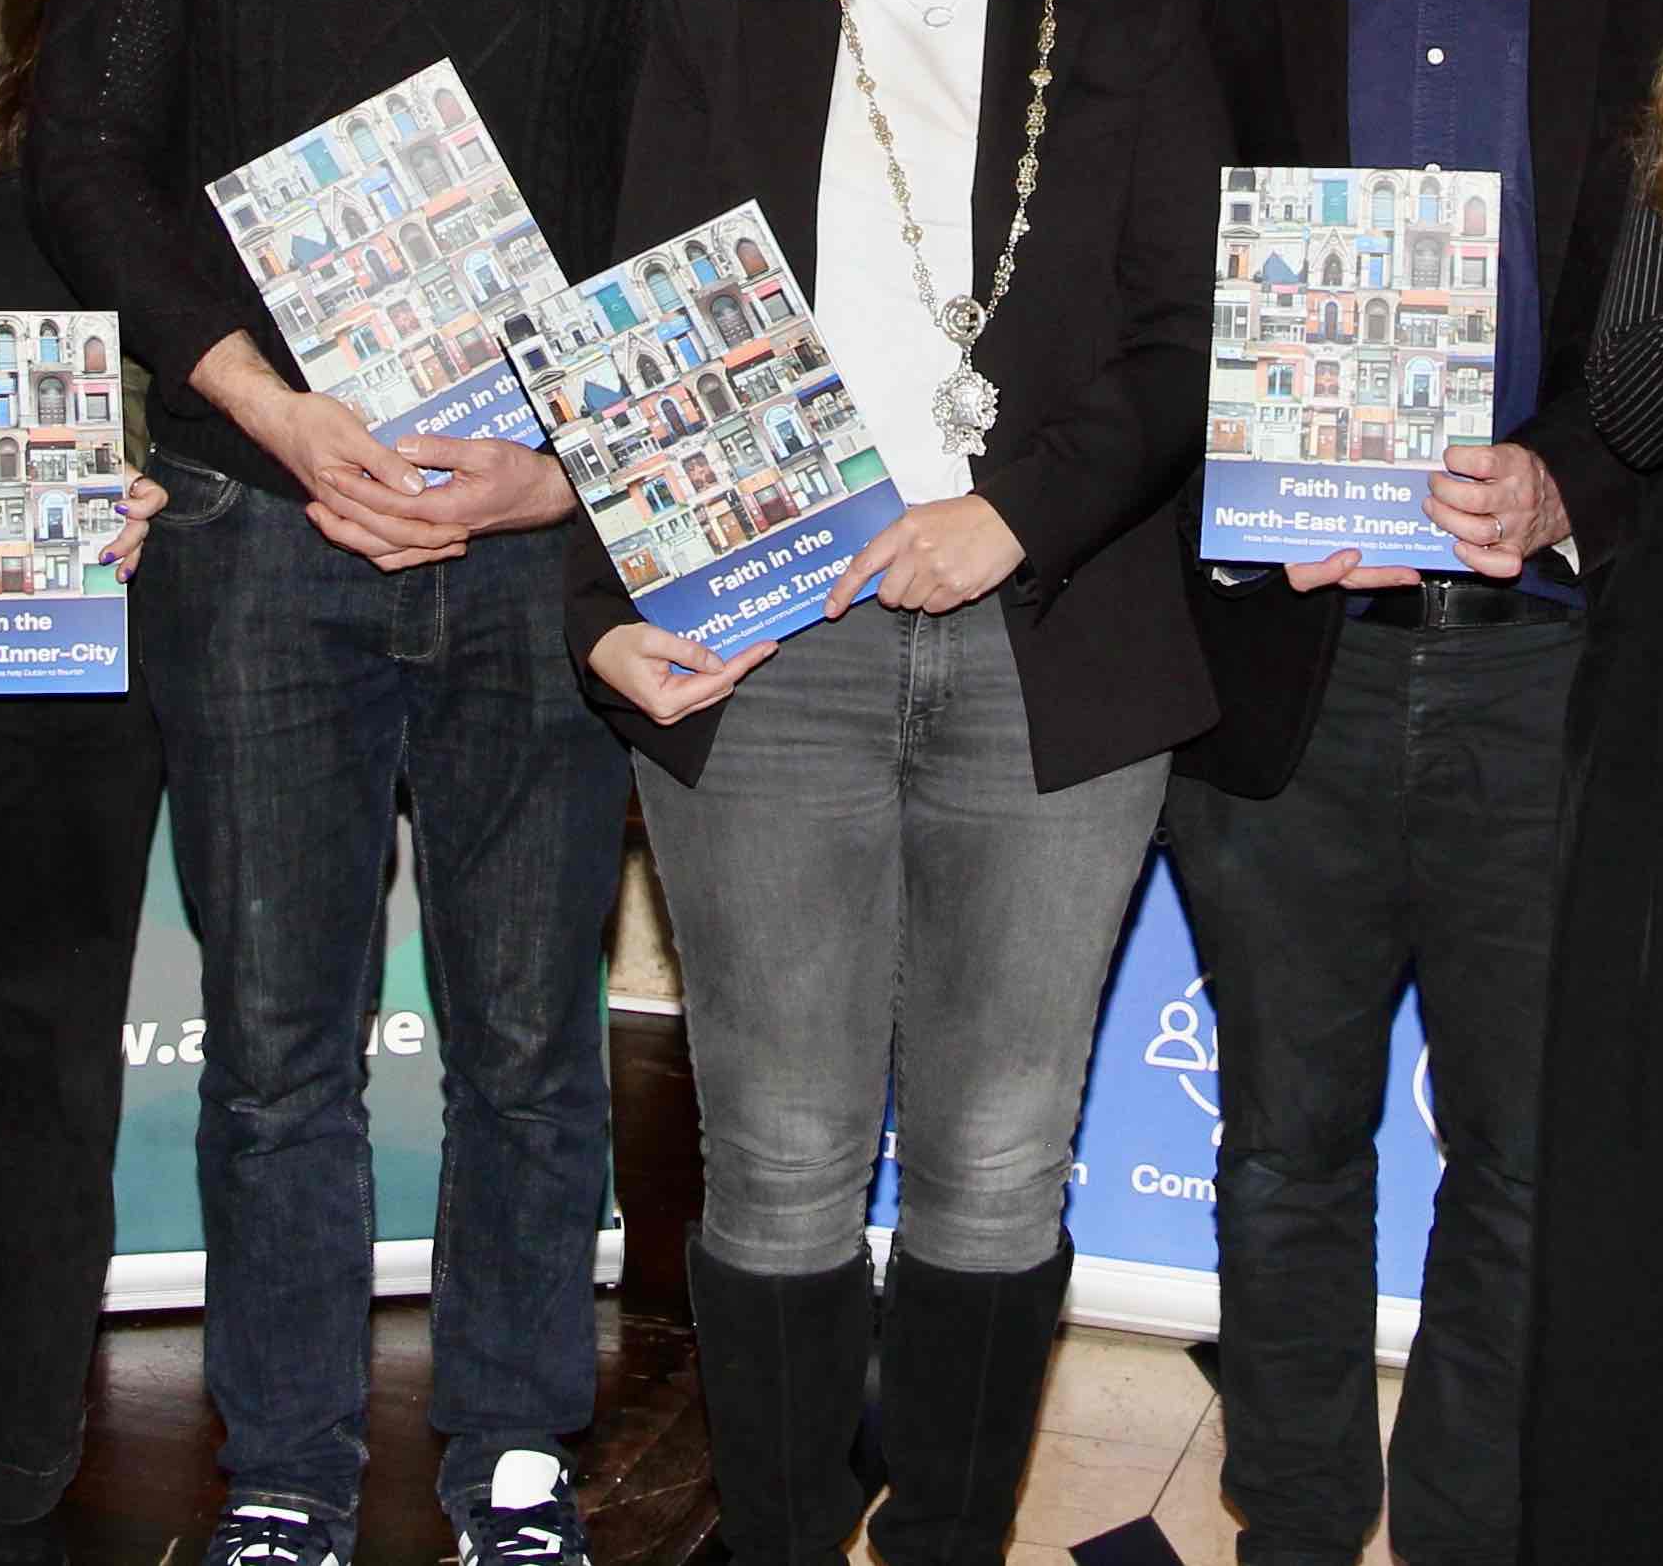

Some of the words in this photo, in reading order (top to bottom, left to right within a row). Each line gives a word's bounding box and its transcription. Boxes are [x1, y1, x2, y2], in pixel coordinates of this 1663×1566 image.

[415, 401, 471, 435] Faith
[471, 389, 494, 409] in
[495, 374, 520, 391] th
[1280, 477, 1338, 499] Faith
[1345, 480, 1366, 500] in
[1370, 481, 1411, 503] the
[1215, 507, 1347, 533] North-East
[708, 560, 768, 597] Faith
[768, 549, 793, 569] in
[794, 529, 834, 556] the
[14, 613, 52, 631] the
[678, 584, 792, 643] orth-East
